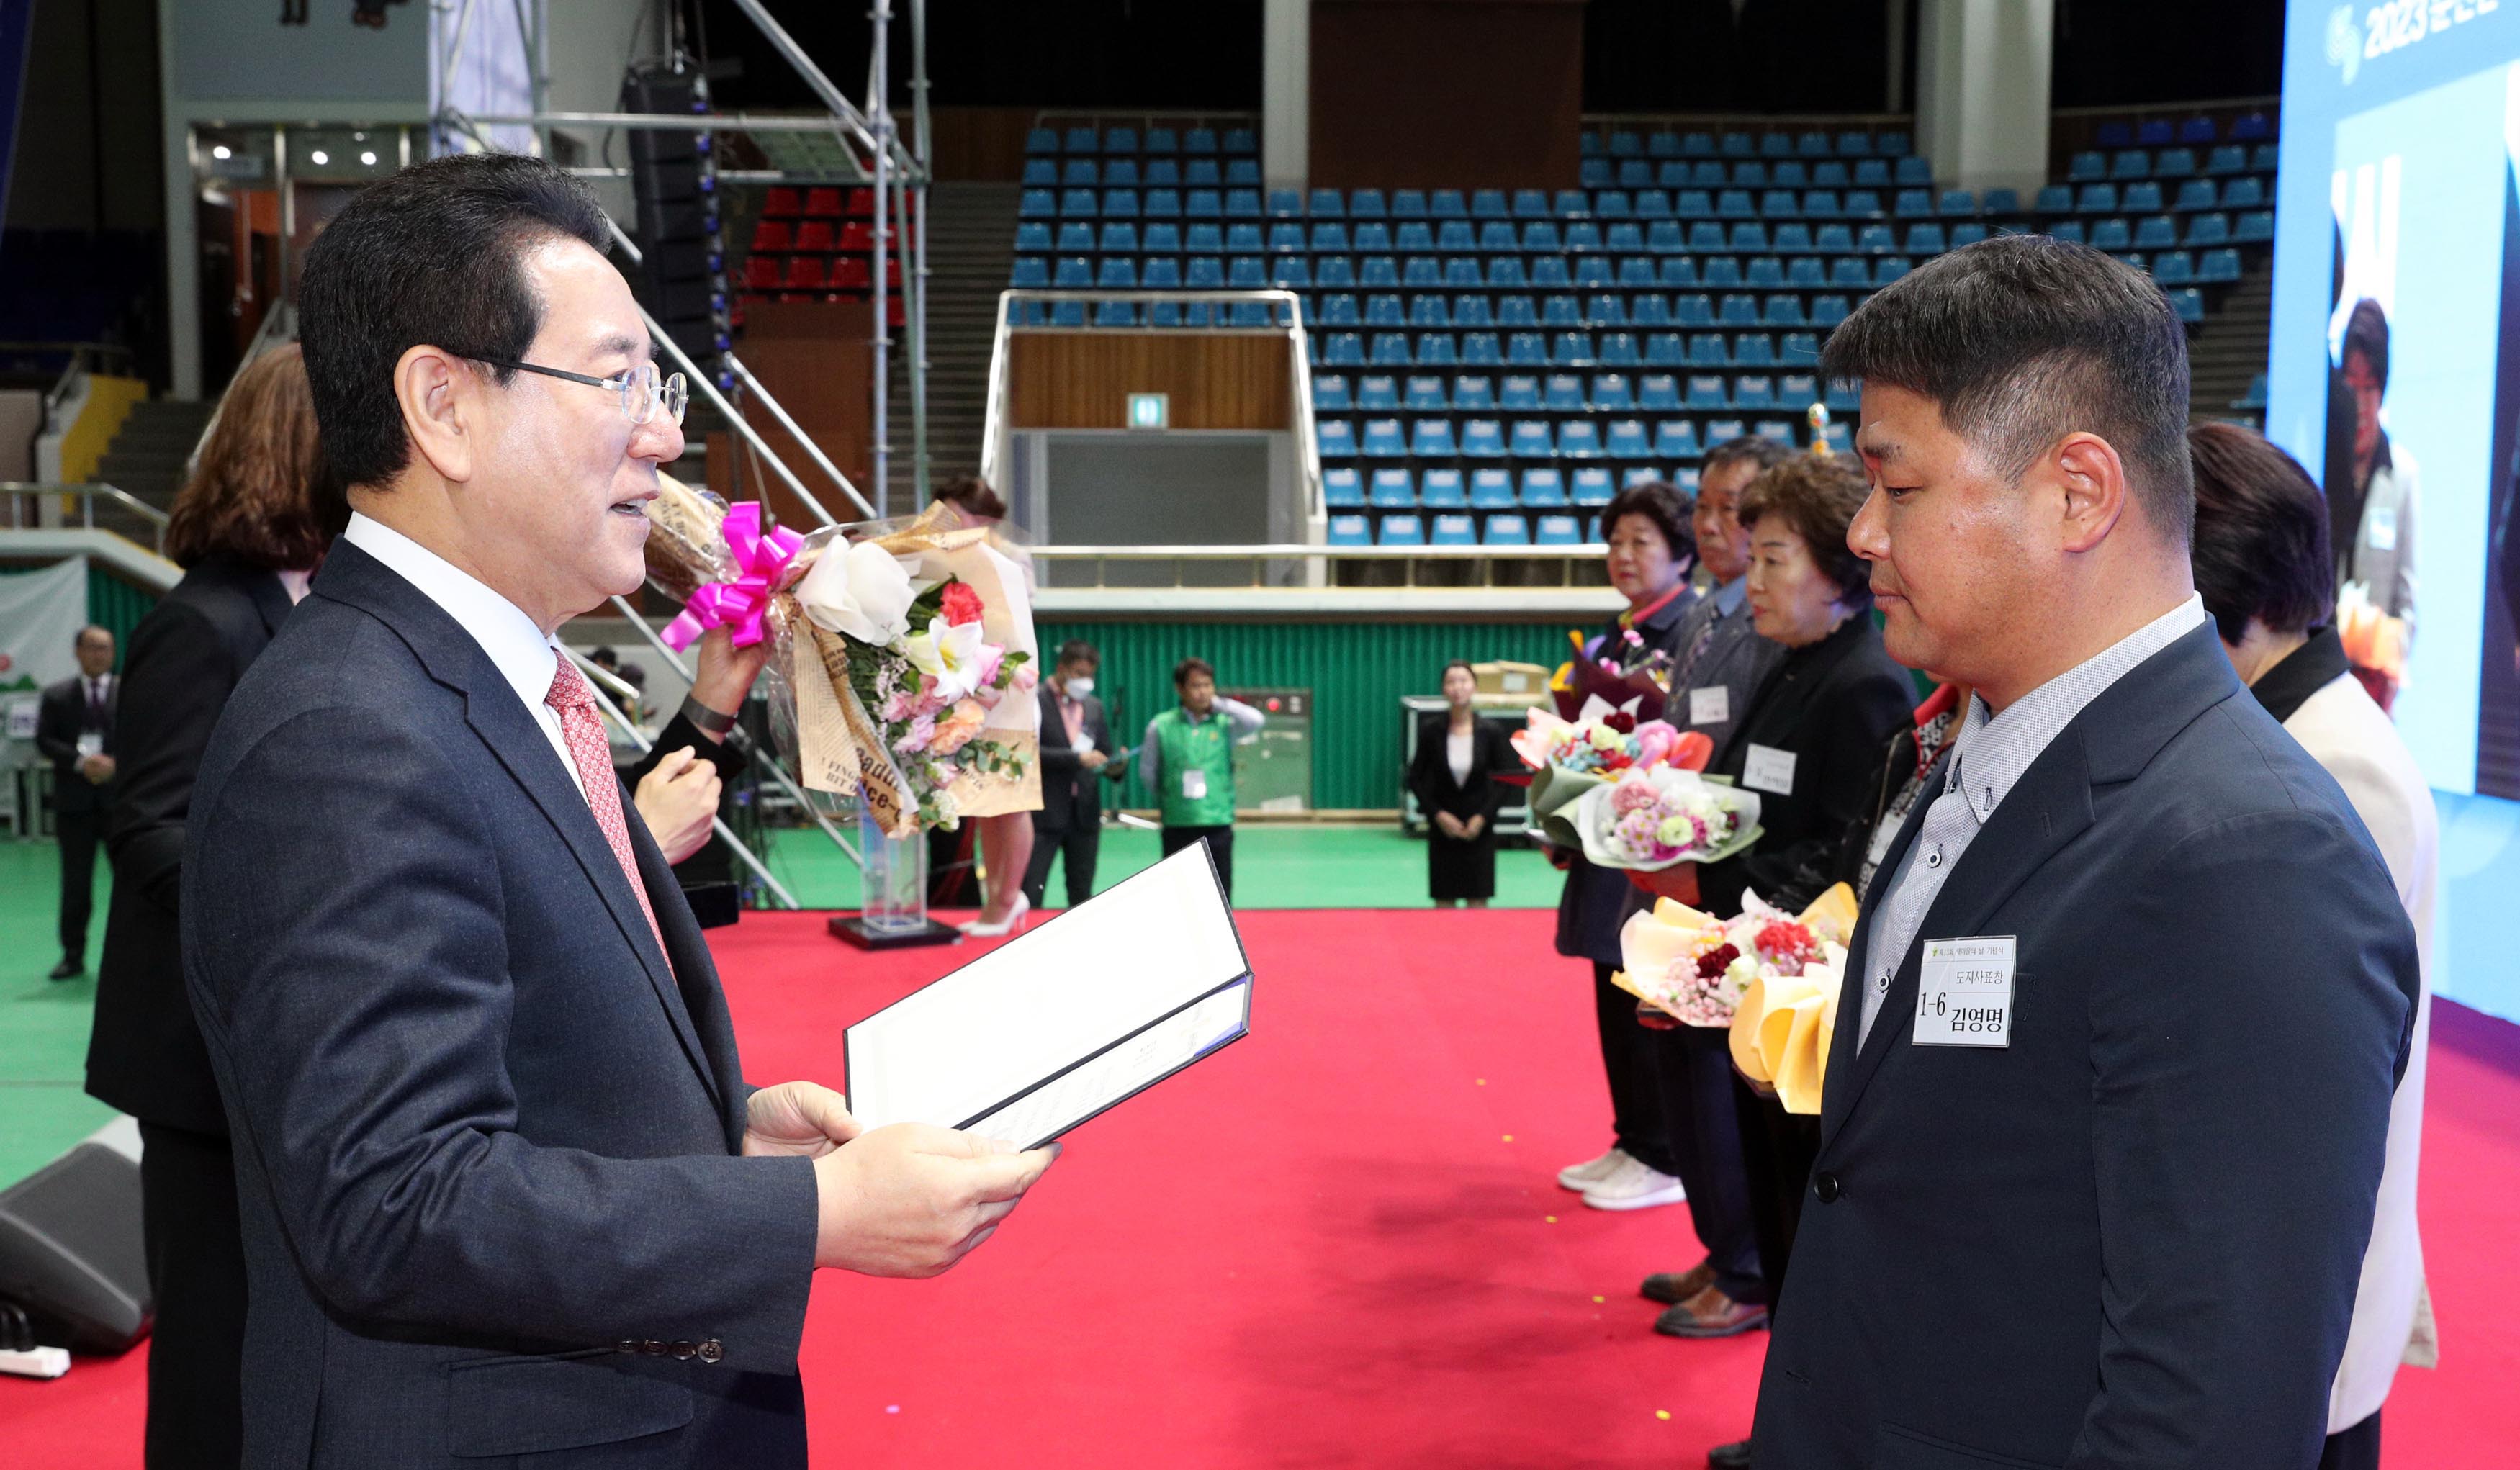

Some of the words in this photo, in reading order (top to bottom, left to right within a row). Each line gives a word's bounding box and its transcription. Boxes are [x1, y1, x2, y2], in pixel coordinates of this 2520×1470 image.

[1986, 946, 2004, 955] 기념식
[1956, 970, 2004, 985] 도지사표창
[1919, 991, 1947, 1016] 1-6
[1950, 1008, 2004, 1033] 김영명
